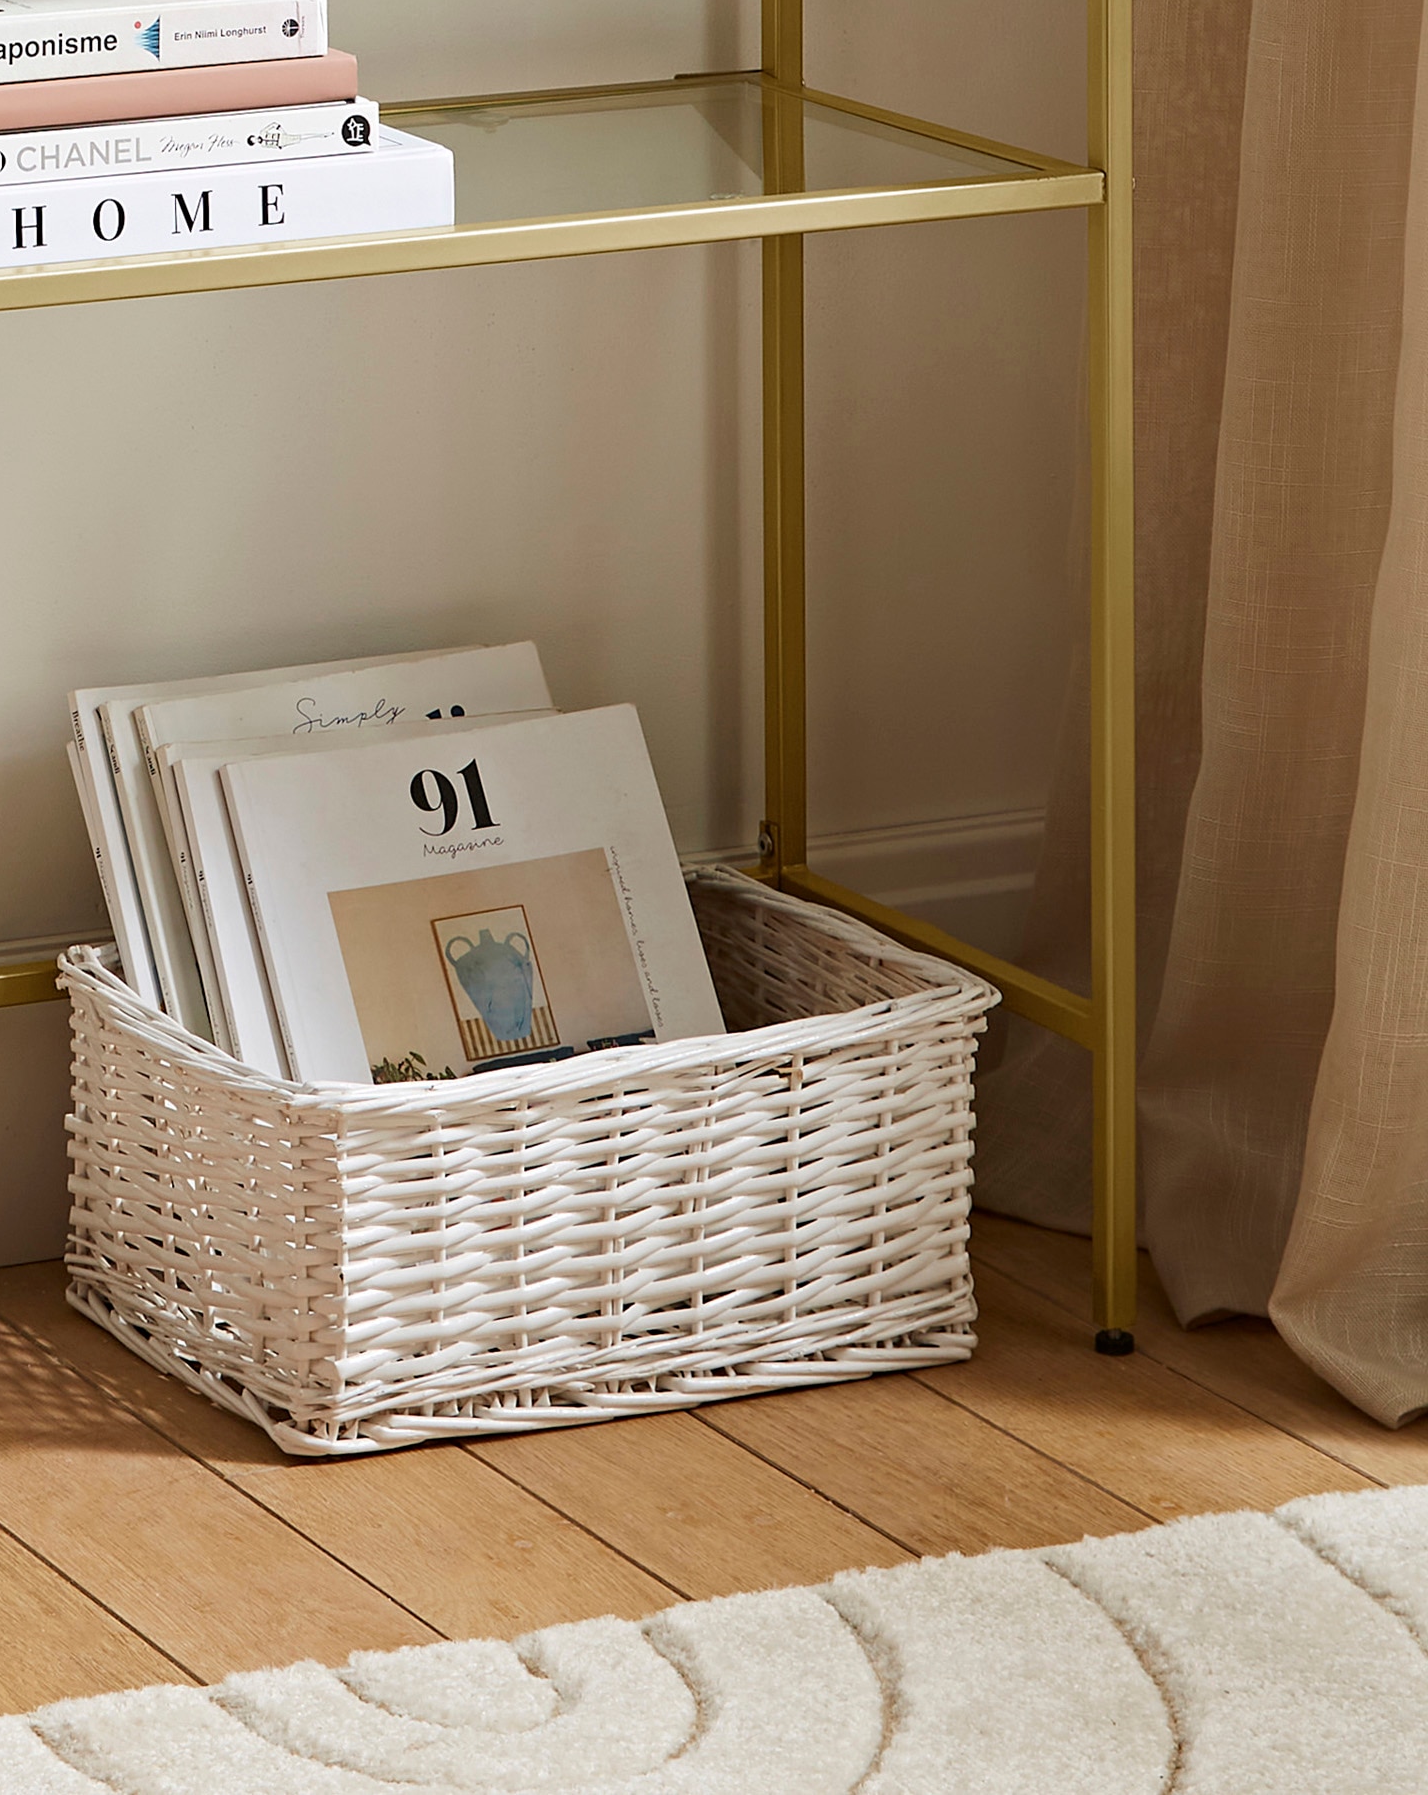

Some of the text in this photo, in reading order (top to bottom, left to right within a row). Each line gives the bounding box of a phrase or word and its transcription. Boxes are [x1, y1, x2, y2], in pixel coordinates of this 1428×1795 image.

[173, 25, 268, 42] Erin Niimi Longhurst
[16, 137, 153, 172] CHANEL
[11, 183, 286, 250] HOME
[71, 709, 86, 753] Breathe
[292, 697, 407, 735] Simply
[409, 757, 502, 838] 91
[422, 835, 505, 860] Magazine
[643, 971, 660, 996] and
